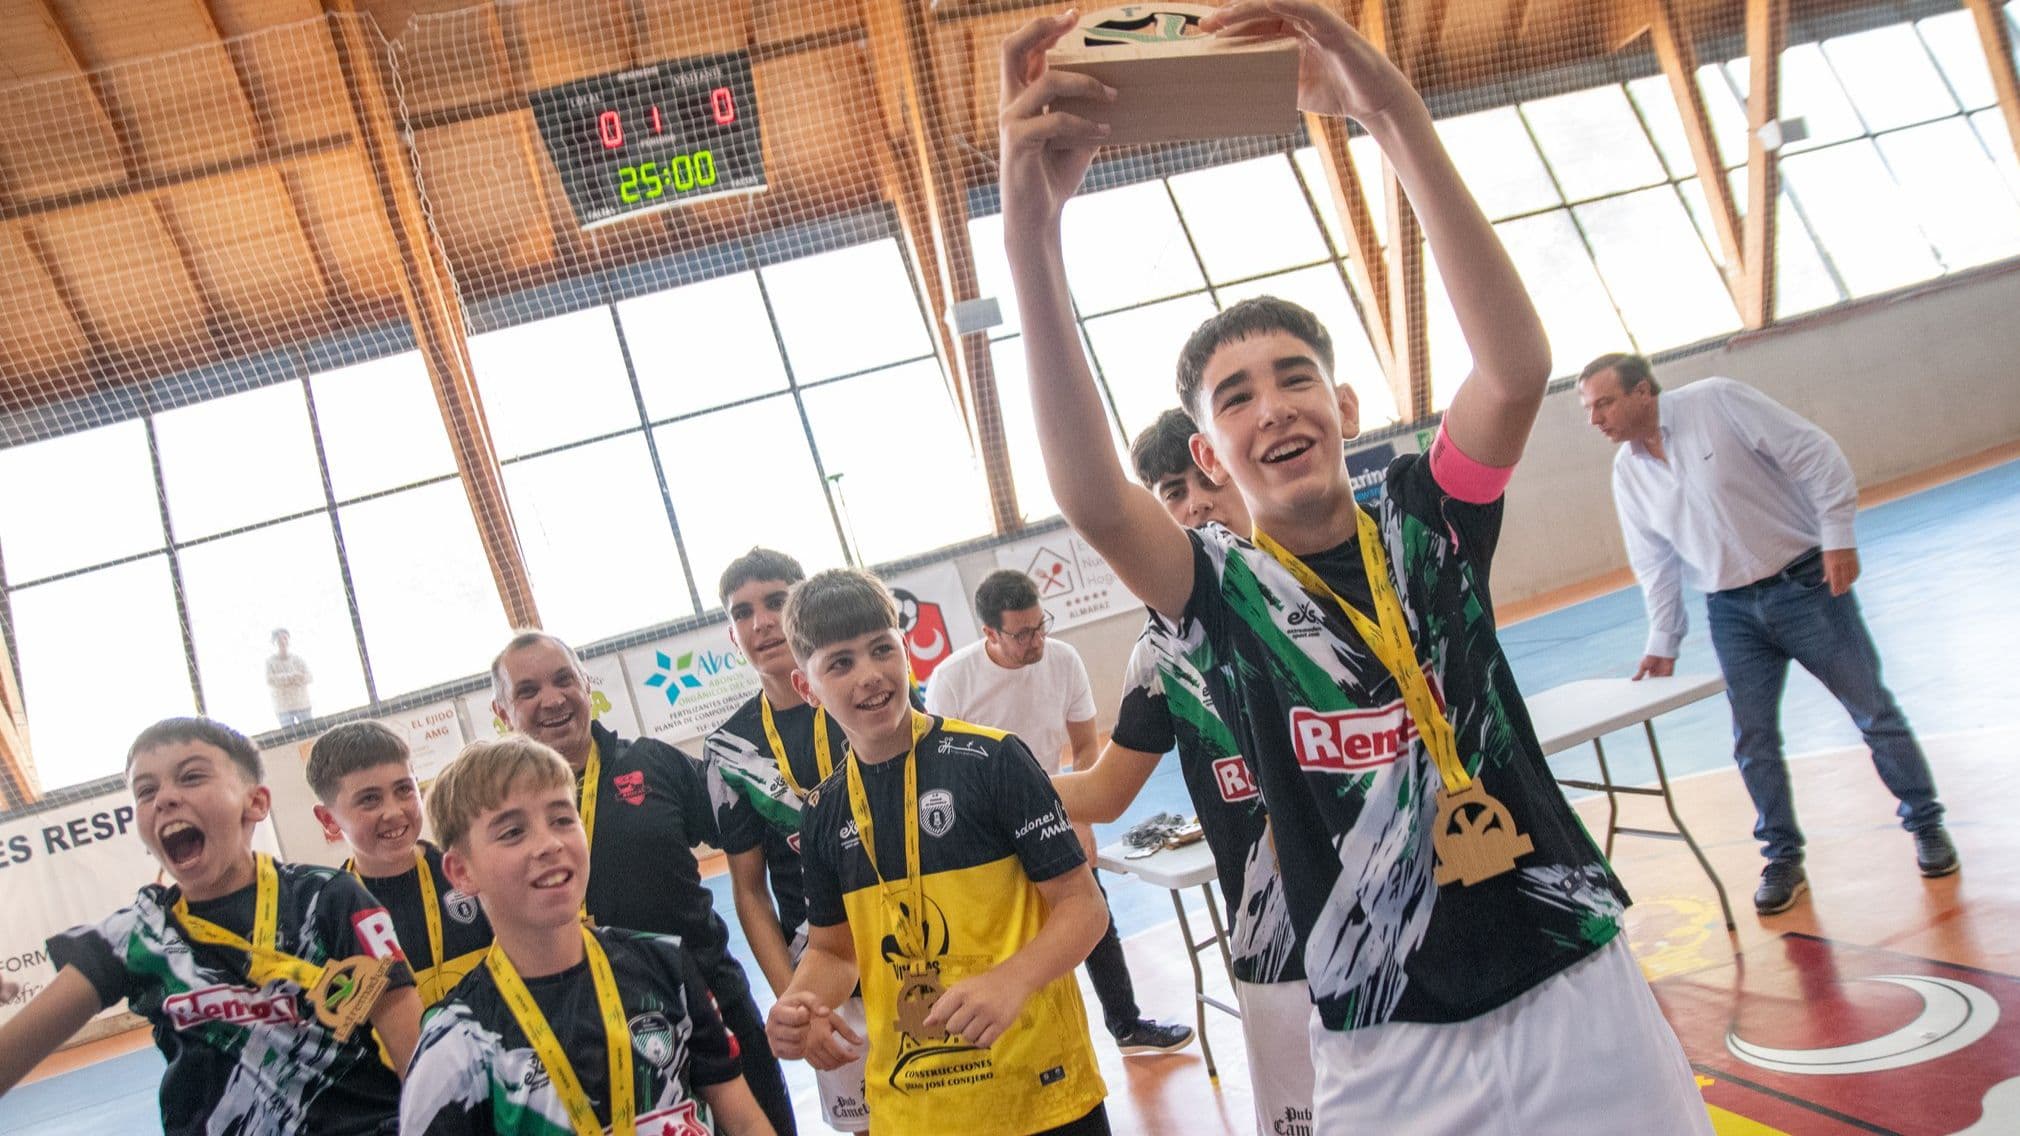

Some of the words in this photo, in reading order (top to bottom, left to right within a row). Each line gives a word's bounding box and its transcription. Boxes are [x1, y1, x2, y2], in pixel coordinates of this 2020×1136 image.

[600, 111, 624, 149] 0
[712, 87, 735, 125] 0
[618, 150, 716, 203] 25:00
[655, 720, 683, 733] PLANTA
[1297, 712, 1412, 762] Rem
[42, 805, 134, 855] RESP
[904, 1058, 993, 1079] CONSTRUCCIONES
